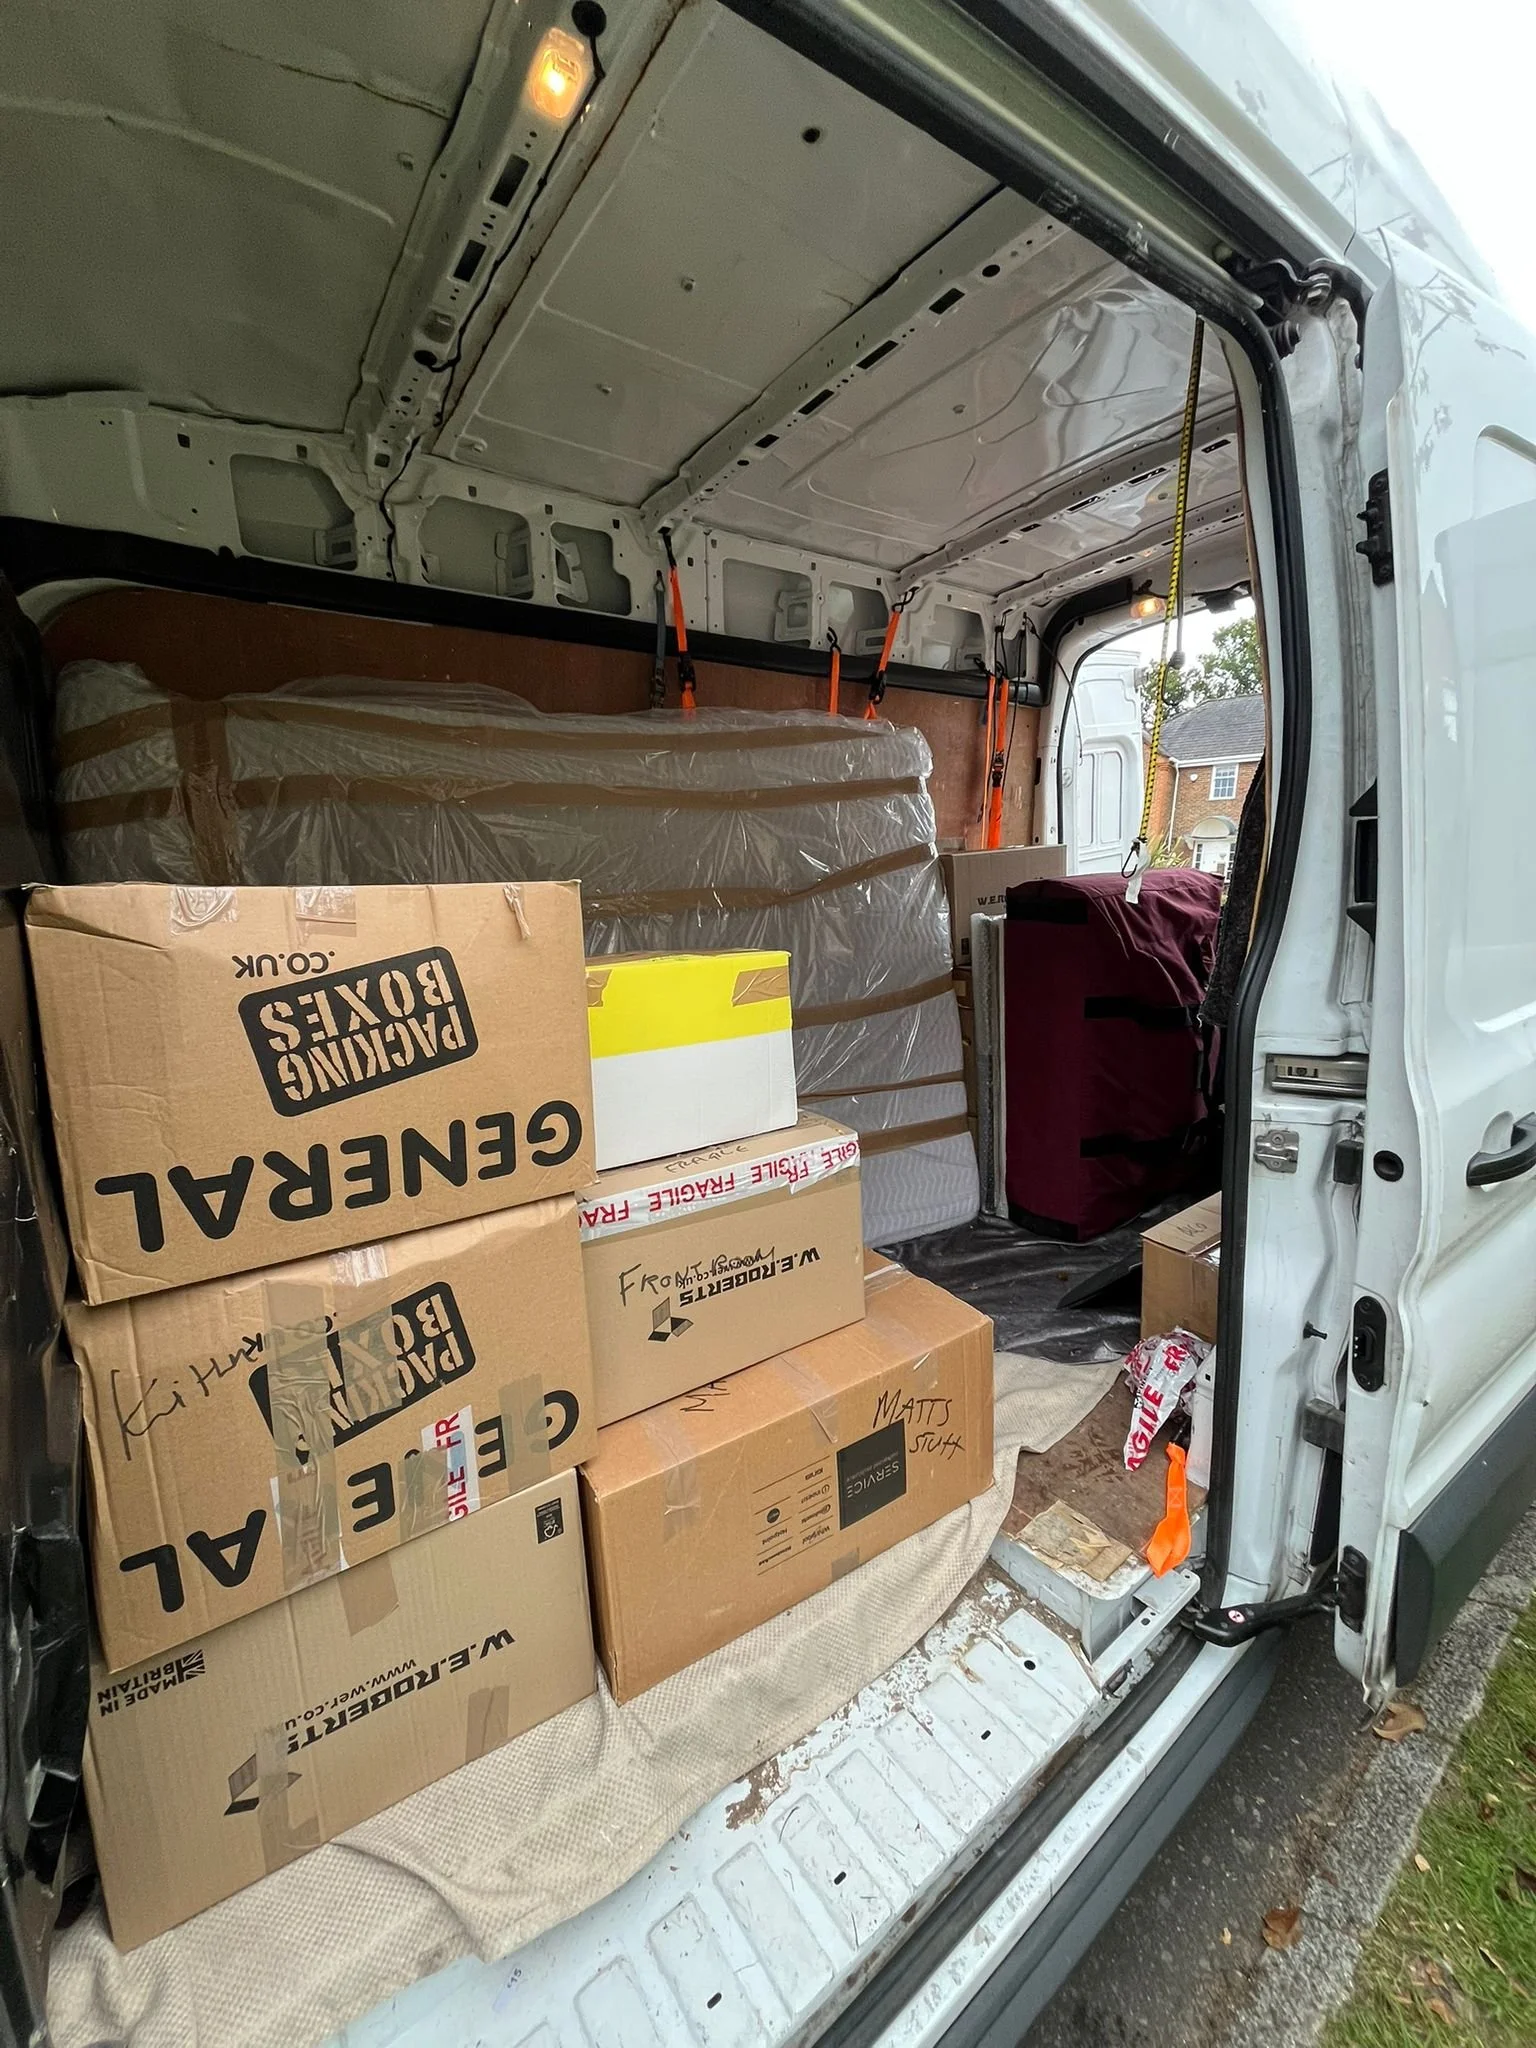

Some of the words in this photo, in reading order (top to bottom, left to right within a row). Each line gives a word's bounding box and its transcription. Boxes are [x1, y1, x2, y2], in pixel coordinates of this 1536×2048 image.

[231, 950, 336, 981] .CO.UK
[258, 957, 455, 1053] BOXES
[275, 1004, 468, 1104] PACKING
[664, 1145, 748, 1173] FRAGILE
[821, 1140, 858, 1170] GILE
[94, 1100, 582, 1254] GENERAL
[648, 1171, 735, 1212] FRAGILE
[579, 1199, 630, 1228] FRA
[618, 1261, 702, 1307] FRONT
[678, 1247, 821, 1308] W.E.ROBERTS
[872, 1388, 952, 1429] MATTS
[846, 1460, 900, 1498] SERVICE
[96, 1661, 176, 1704] BRITAIN
[123, 1676, 177, 1708] MADE
[284, 1658, 418, 1732] www.wer.co.u
[98, 1699, 121, 1718] IN
